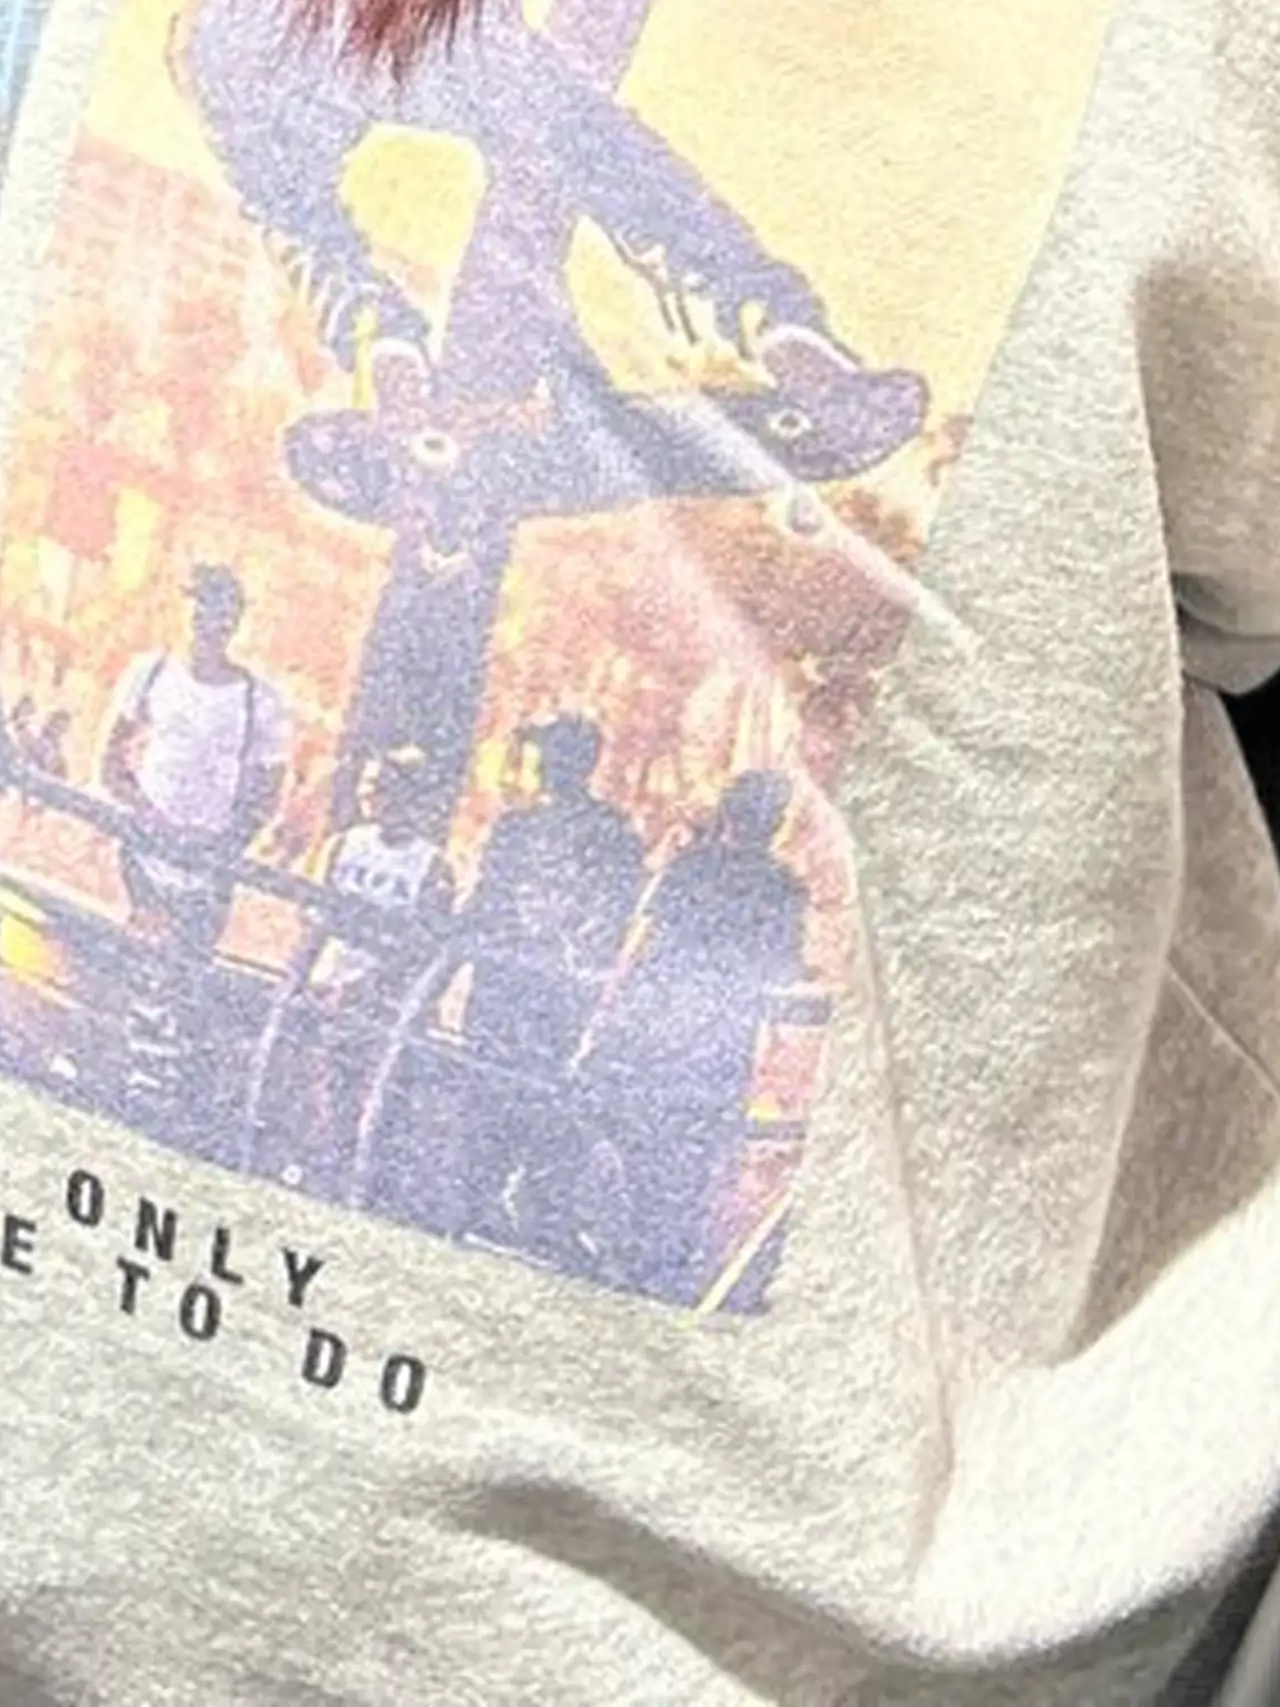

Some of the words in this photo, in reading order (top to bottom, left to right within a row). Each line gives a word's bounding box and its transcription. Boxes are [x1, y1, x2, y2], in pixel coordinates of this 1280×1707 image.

[65, 1169, 325, 1307] ONLY
[116, 1258, 222, 1342] TO
[301, 1328, 426, 1415] DO
